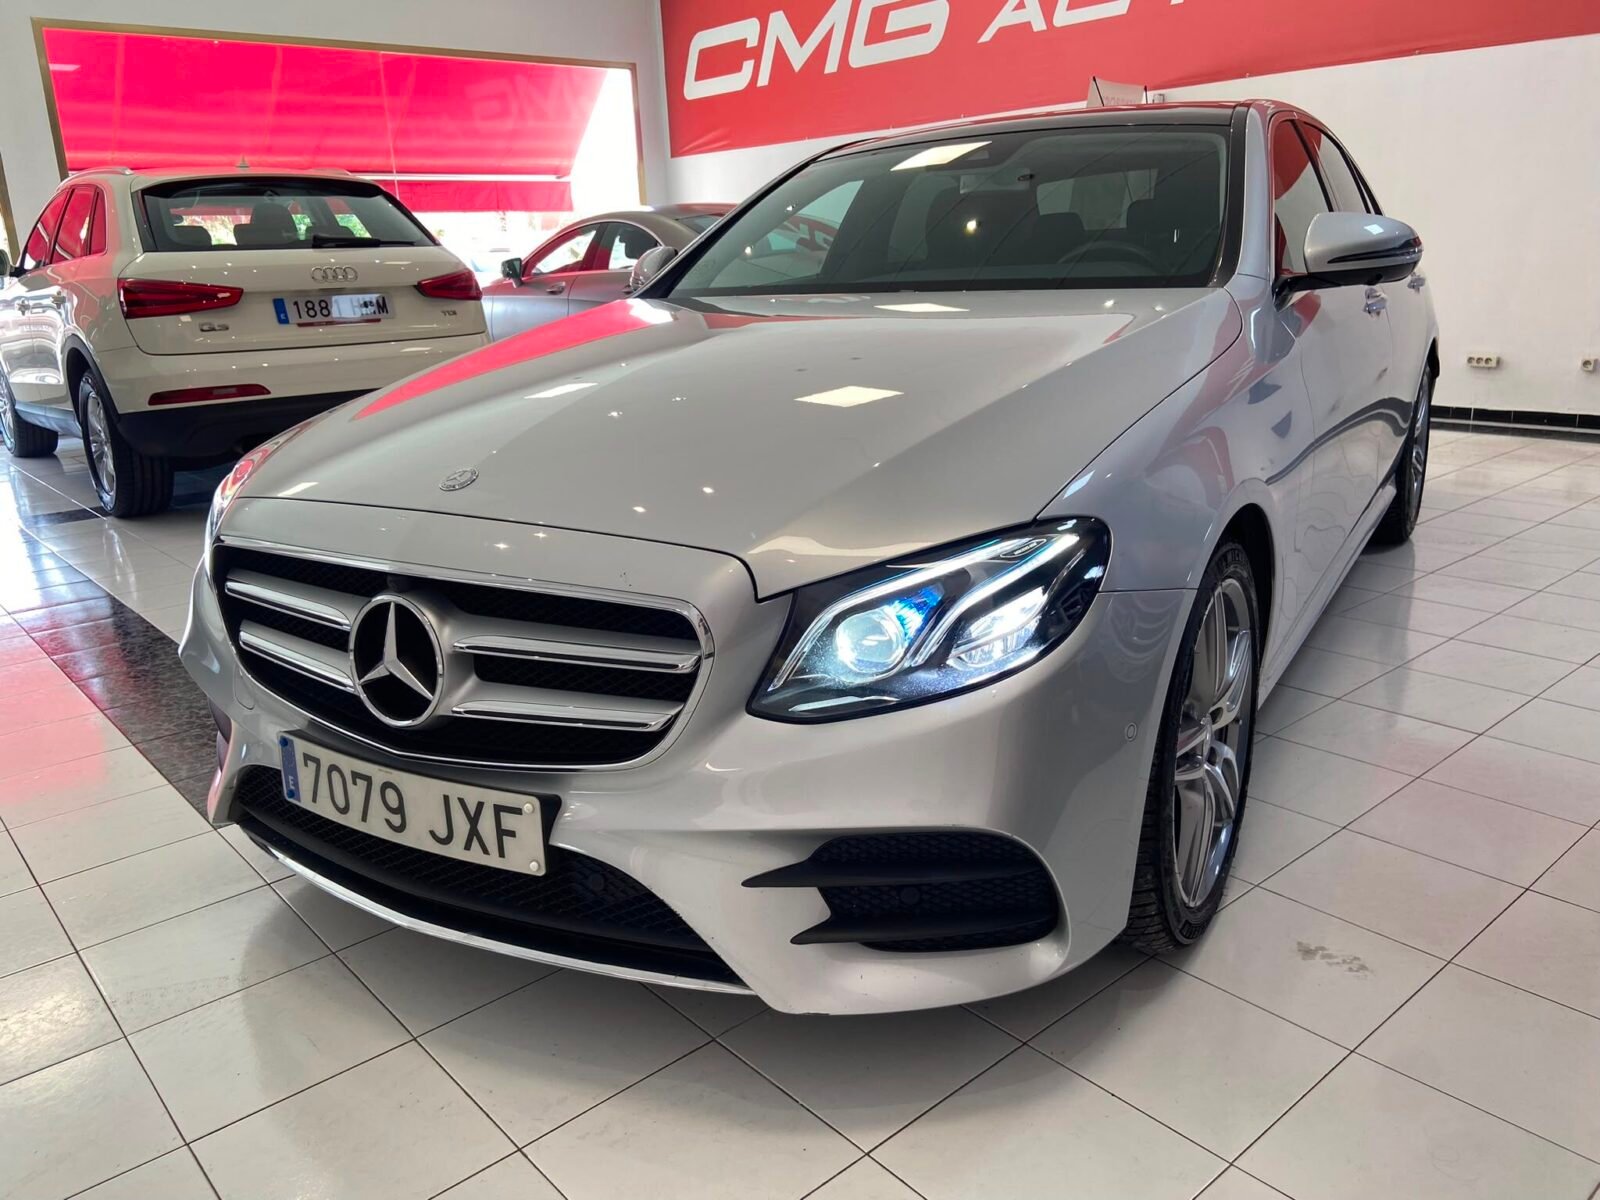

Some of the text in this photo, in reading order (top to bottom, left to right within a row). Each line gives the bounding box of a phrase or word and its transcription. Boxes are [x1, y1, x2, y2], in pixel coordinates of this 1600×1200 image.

[683, 0, 950, 100] CMG
[199, 322, 229, 333] Q3
[288, 775, 296, 790] E
[302, 752, 523, 859] 7079 JXF
